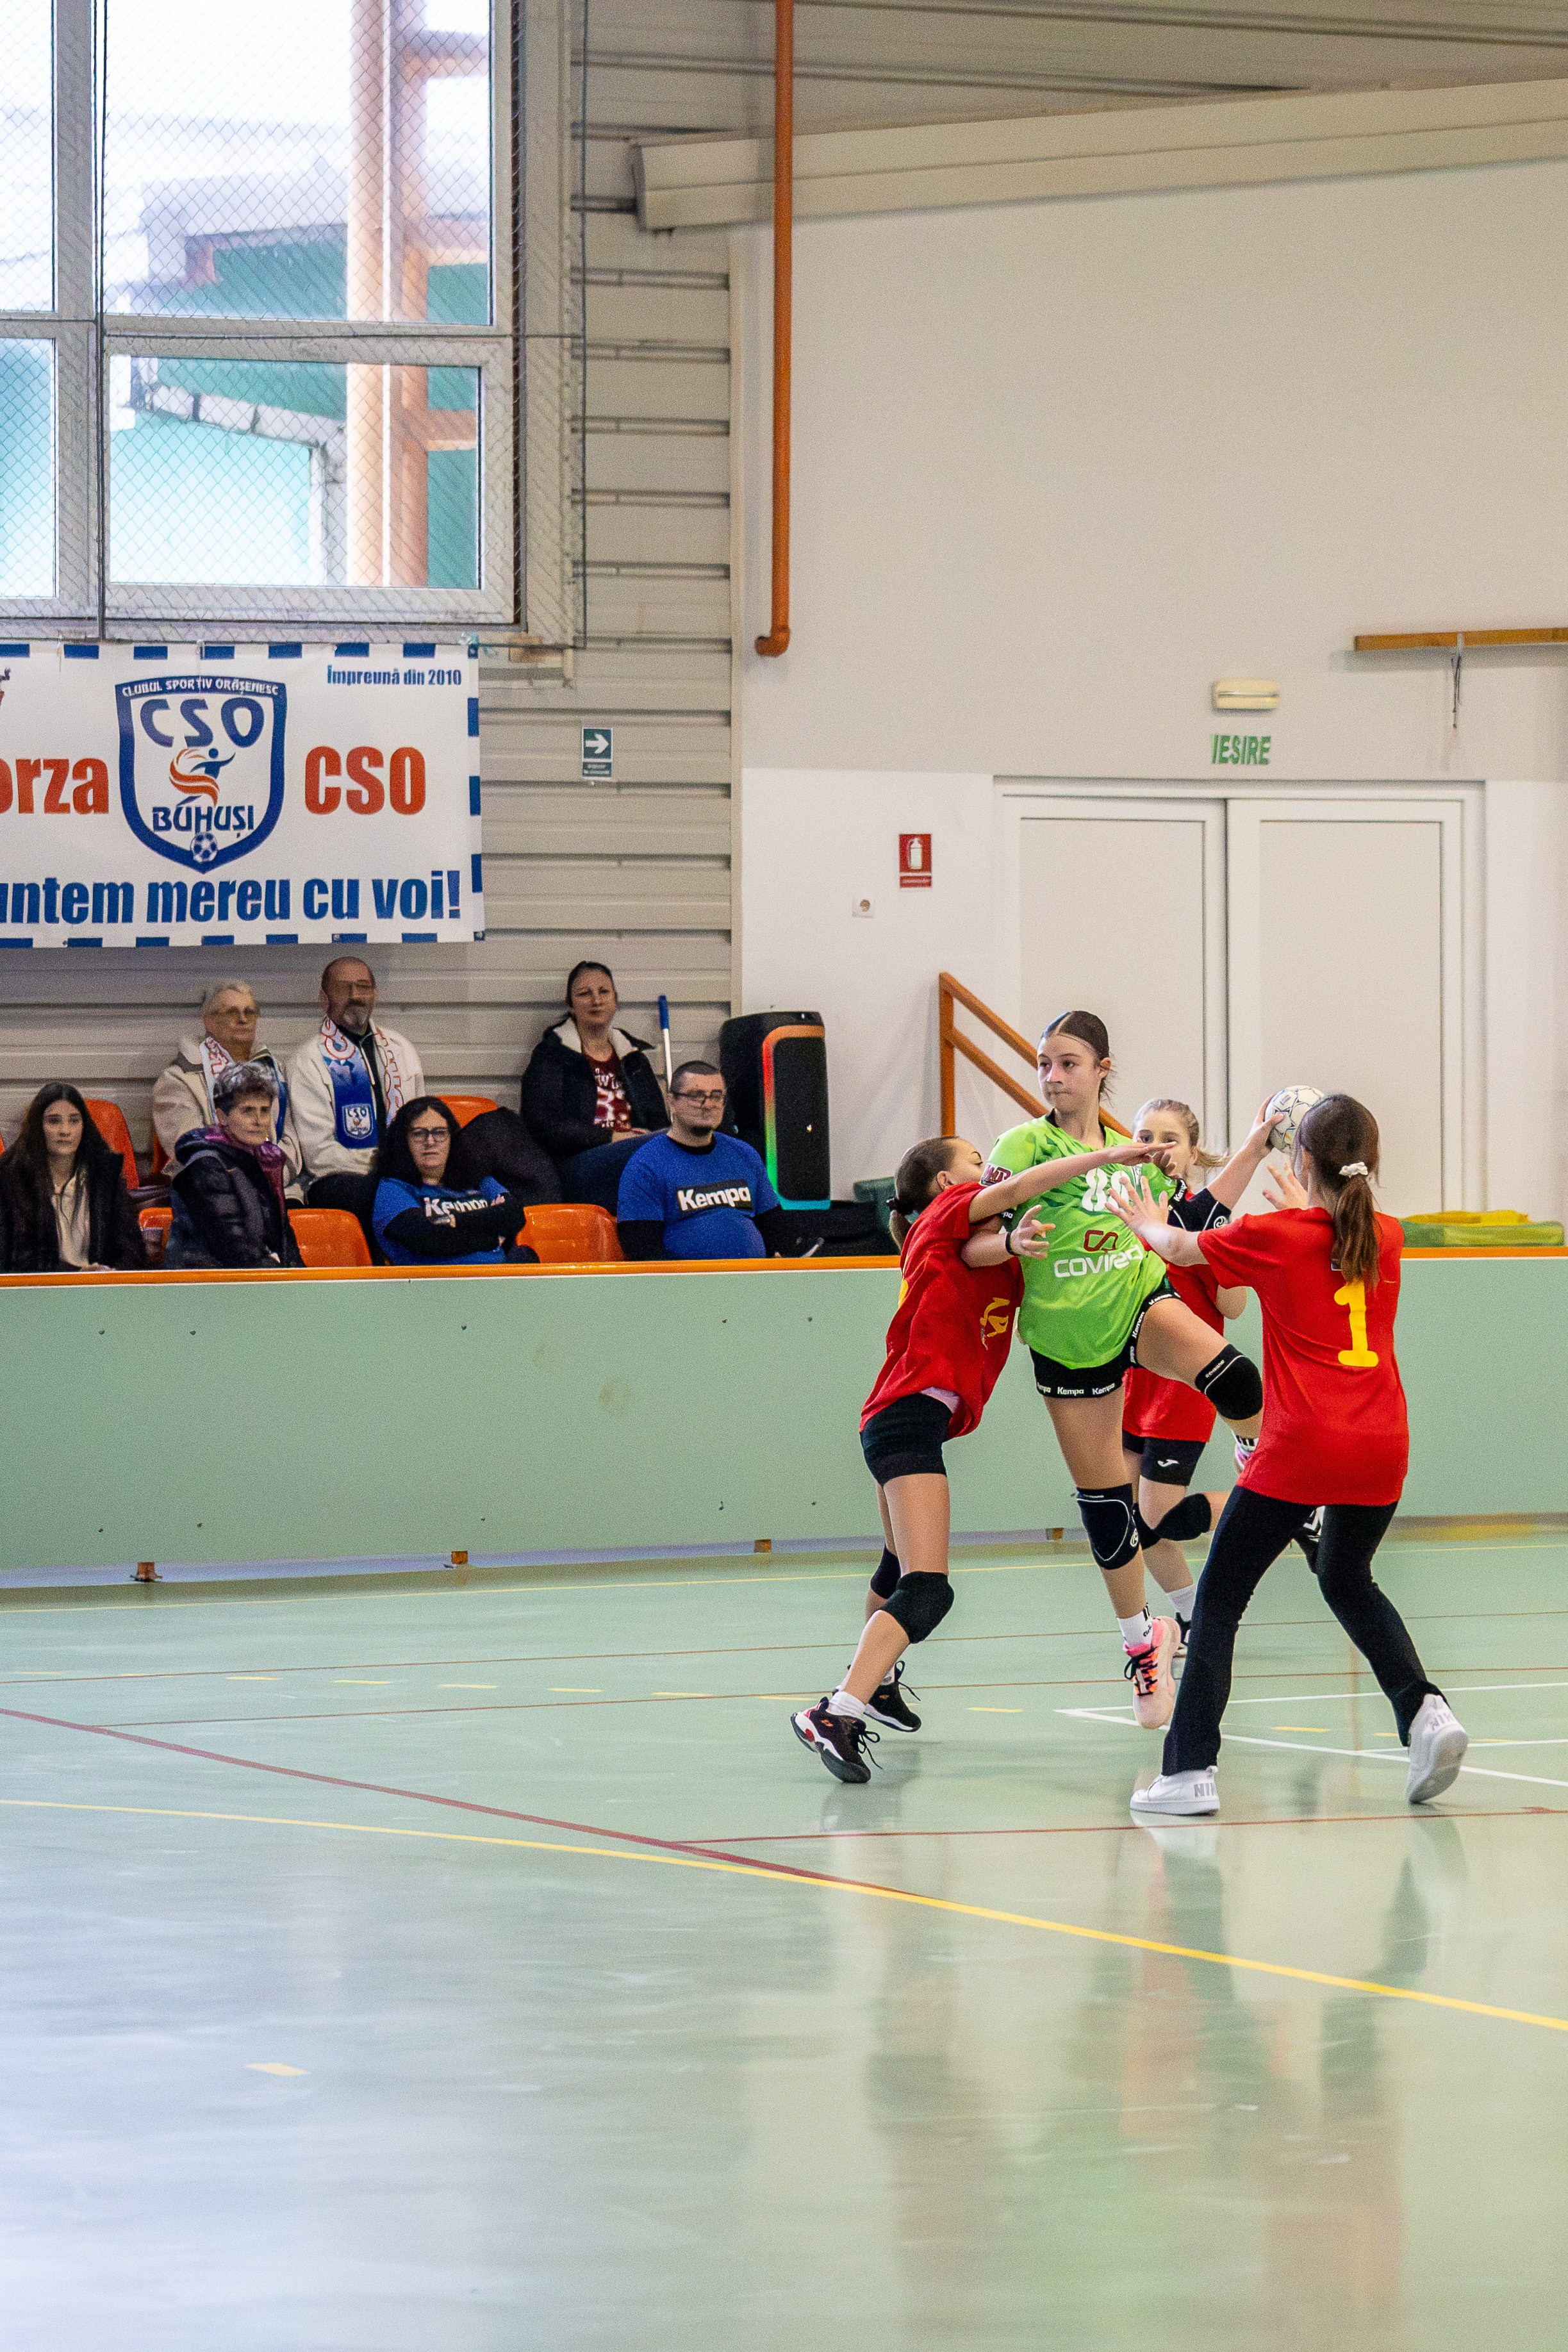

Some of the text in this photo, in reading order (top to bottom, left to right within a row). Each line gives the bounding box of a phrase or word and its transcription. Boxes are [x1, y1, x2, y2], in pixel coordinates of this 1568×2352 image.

[404, 669, 425, 685] din
[428, 669, 462, 686] 2010
[140, 699, 265, 748] CSO
[305, 746, 426, 816] CSO
[147, 881, 291, 924] mereu
[303, 878, 359, 920] cu
[372, 870, 461, 920] voi!
[677, 1187, 751, 1211] Kempa
[1333, 1278, 1379, 1367] 1
[1057, 1387, 1084, 1396] Kempa
